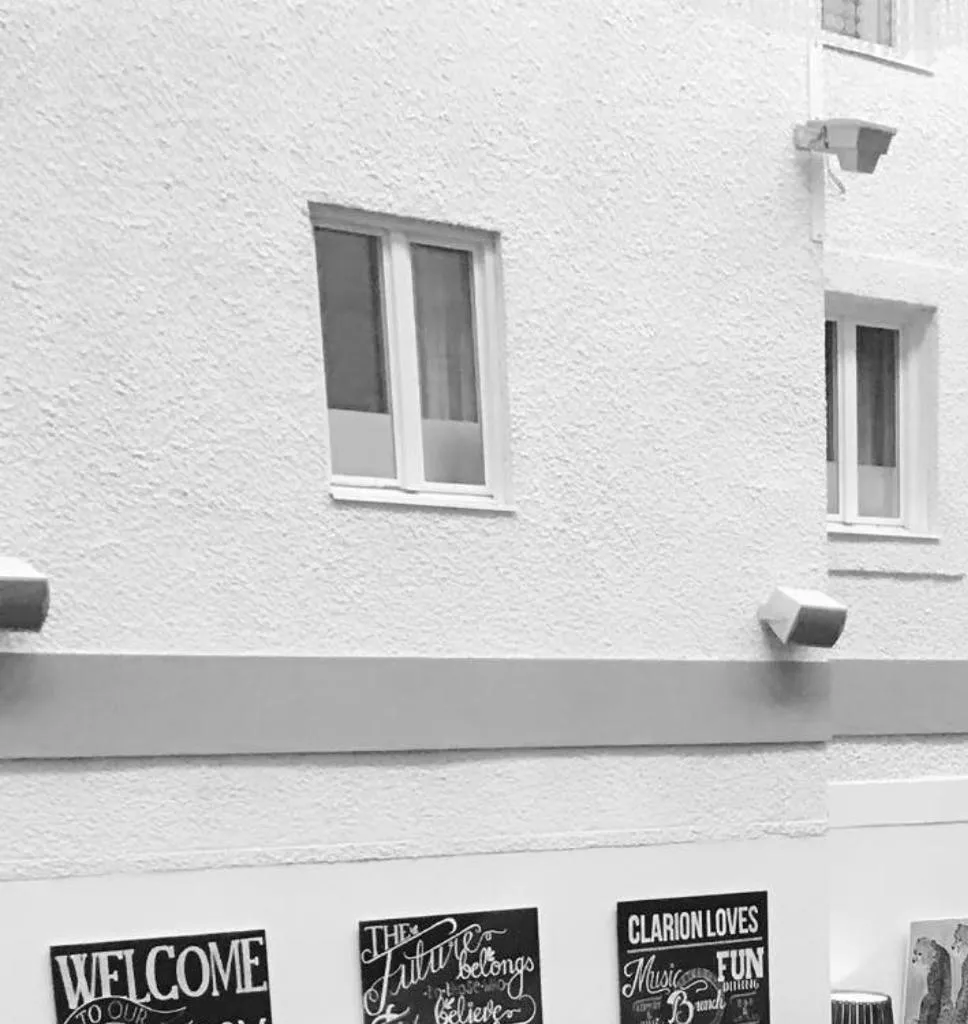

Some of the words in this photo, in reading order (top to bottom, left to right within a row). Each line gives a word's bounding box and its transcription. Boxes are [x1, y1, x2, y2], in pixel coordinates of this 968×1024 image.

[364, 923, 412, 958] THE
[628, 910, 703, 944] CLARION
[706, 905, 759, 938] LOVES
[54, 937, 268, 1010] WELCOME
[622, 954, 682, 998] Music
[716, 947, 764, 983] FUN
